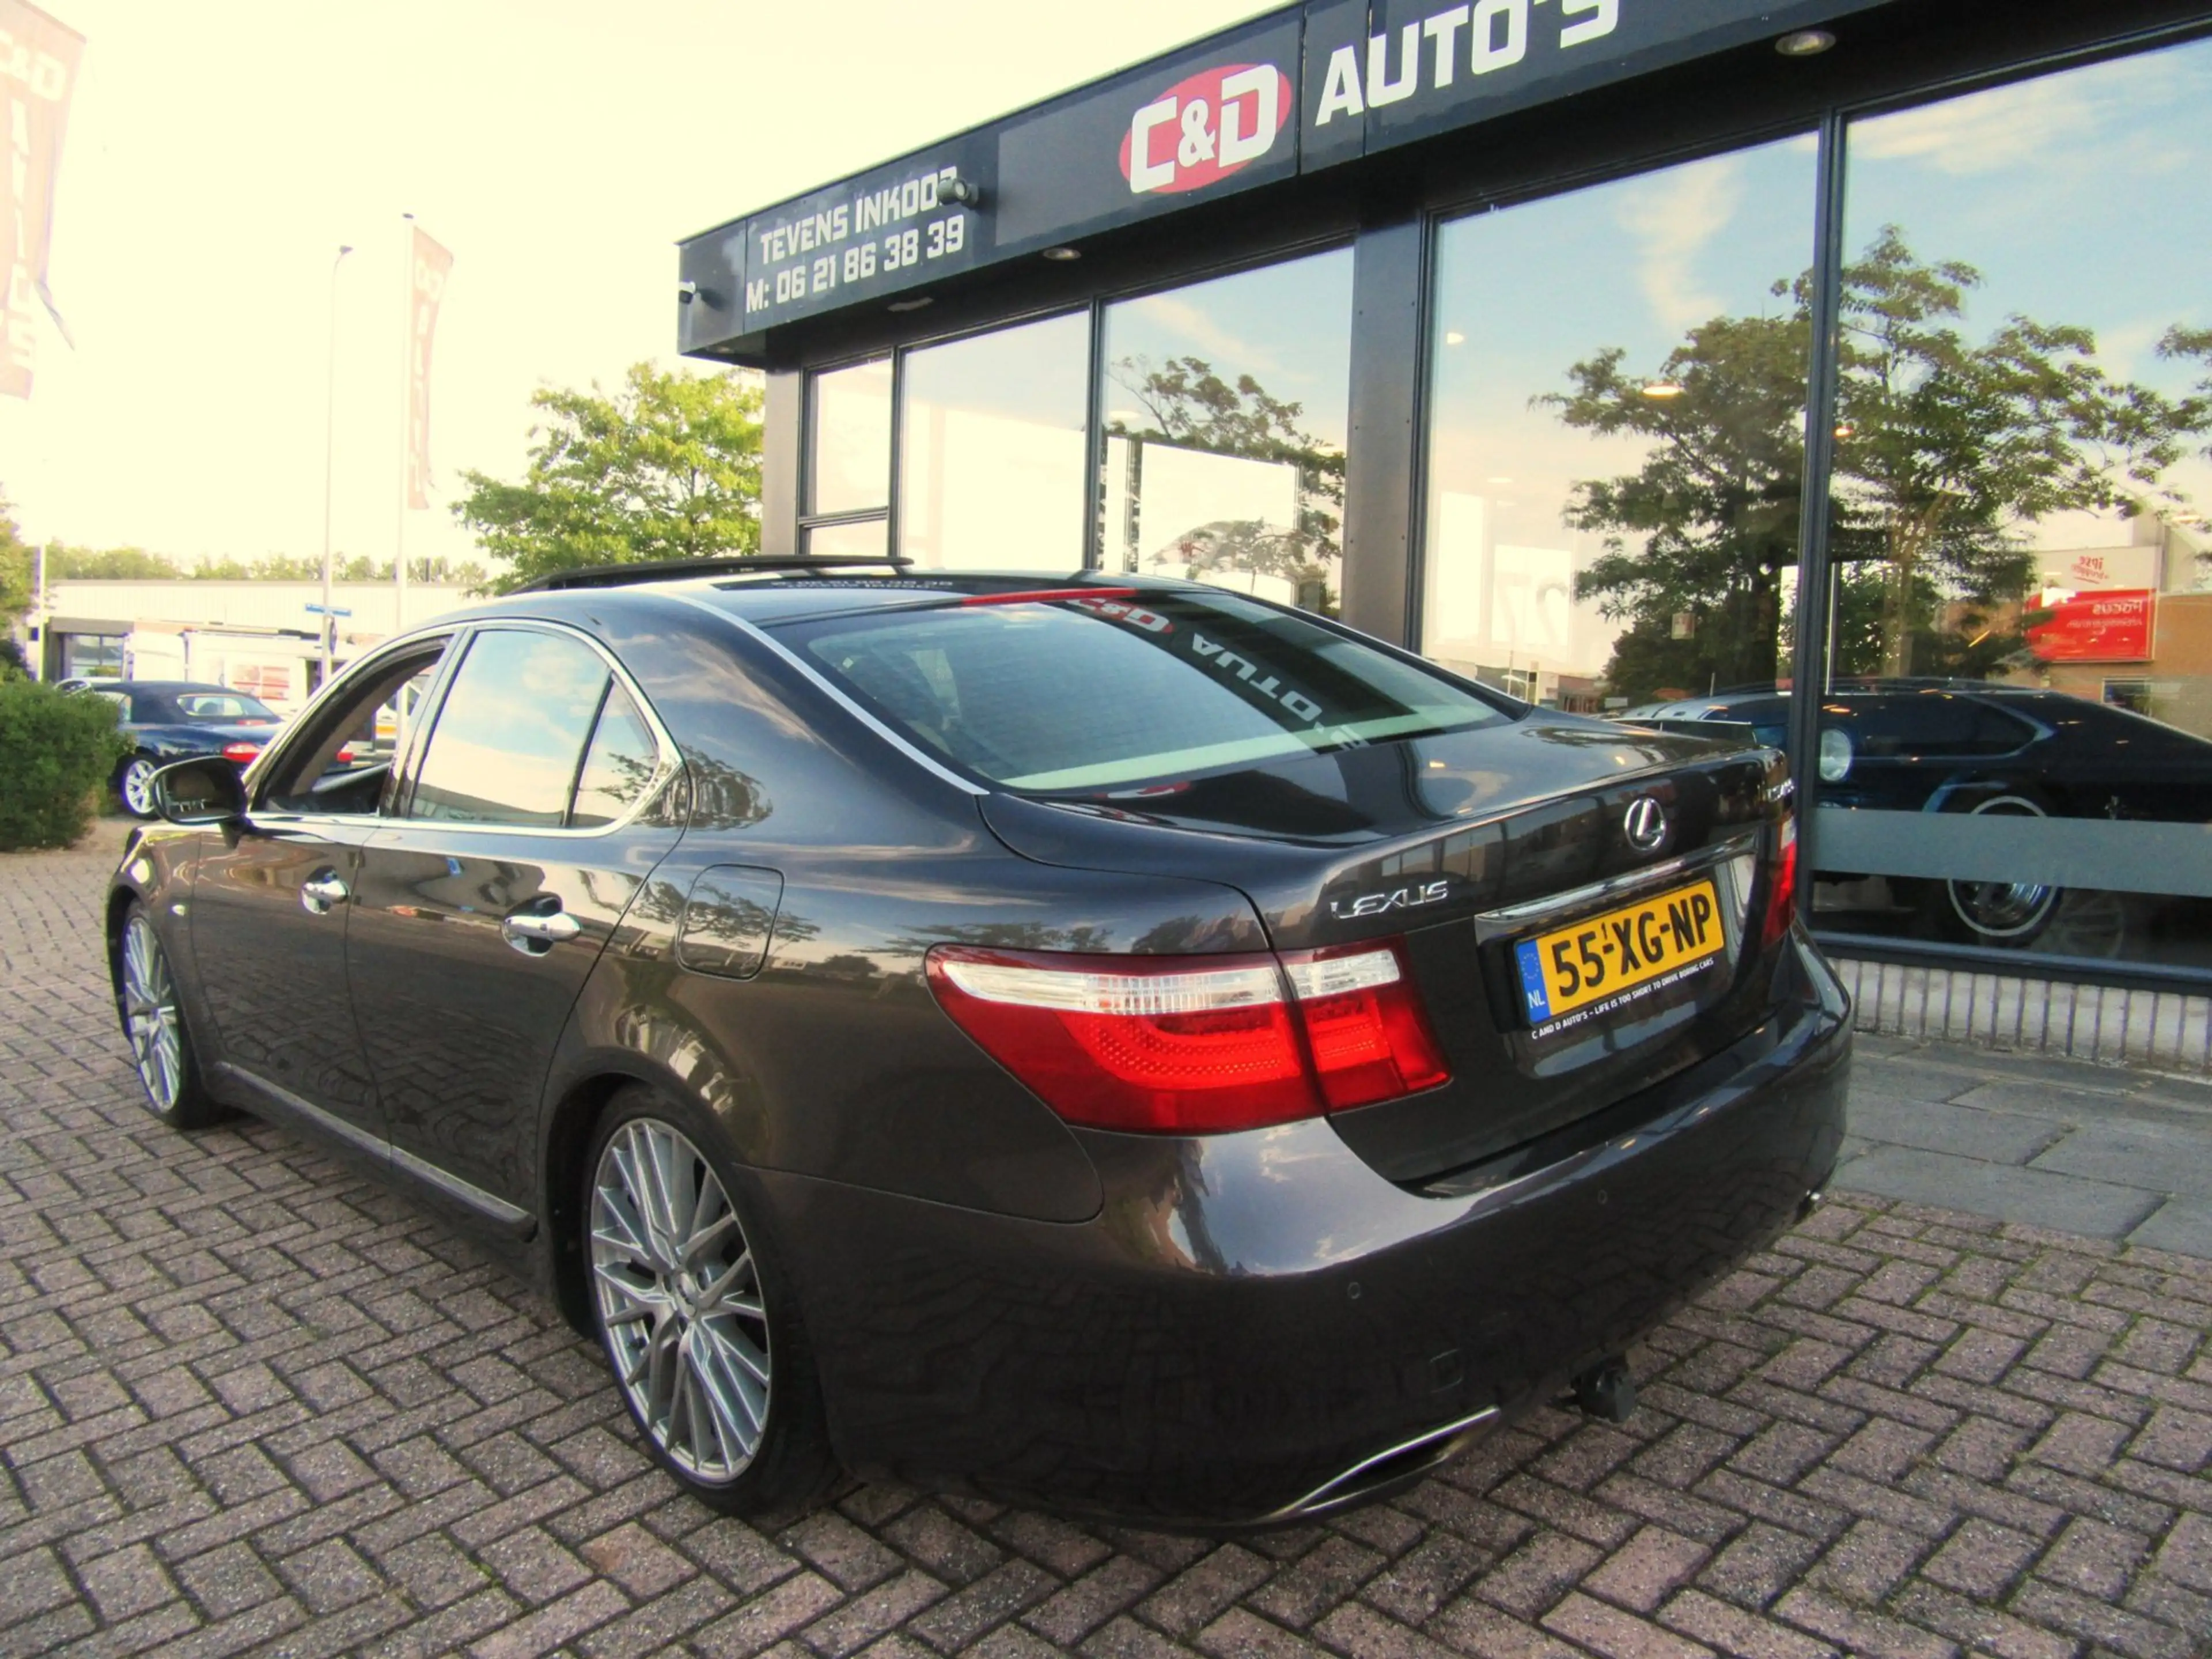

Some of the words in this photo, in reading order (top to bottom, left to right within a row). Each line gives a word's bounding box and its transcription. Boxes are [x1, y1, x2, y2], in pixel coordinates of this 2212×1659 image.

[1130, 64, 1279, 194] C&D
[1315, 0, 1619, 126] AUTOS
[747, 278, 770, 313] M:
[777, 266, 805, 304] 06
[813, 255, 836, 291] 21
[844, 242, 876, 282] 86
[884, 229, 918, 272] 38
[927, 214, 964, 259] 39
[760, 204, 848, 265] TEVENS
[1330, 880, 1448, 919] LEXUS
[1551, 893, 1710, 997] 55-XG-NP
[1528, 989, 1546, 1009] NL
[1531, 1031, 1537, 1039] C
[1539, 1024, 1554, 1037] AND
[1555, 1021, 1561, 1030] D
[1562, 1012, 1588, 1027] AUTO'S
[1594, 1002, 1610, 1014] LIFE
[1611, 999, 1618, 1007] IS
[1619, 994, 1631, 1005] TOO
[1632, 984, 1652, 999] SHORT
[1653, 979, 1661, 990] TO
[1699, 957, 1714, 971] CARS
